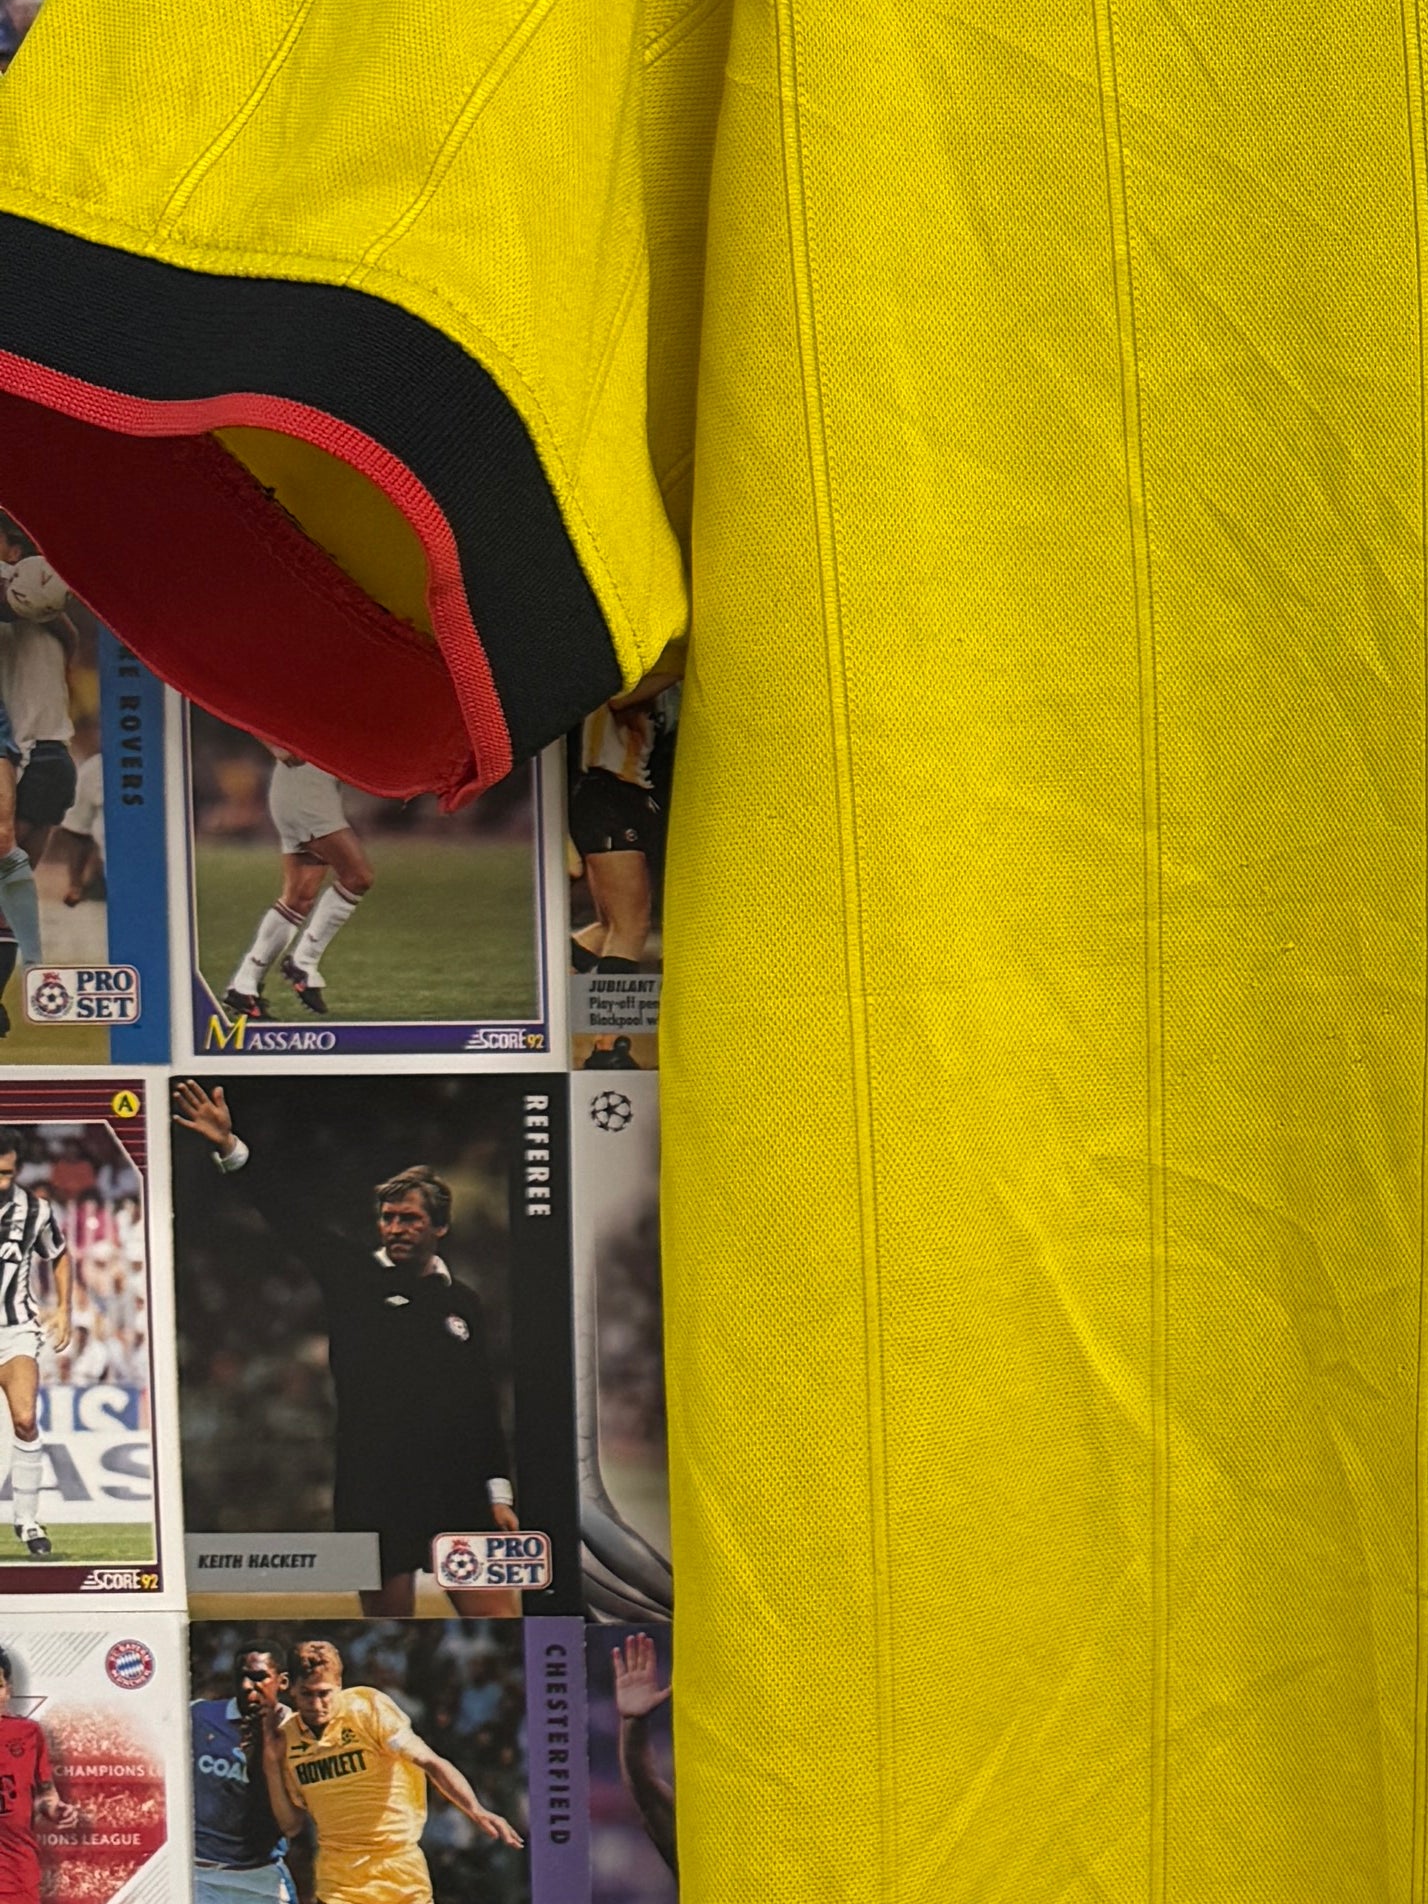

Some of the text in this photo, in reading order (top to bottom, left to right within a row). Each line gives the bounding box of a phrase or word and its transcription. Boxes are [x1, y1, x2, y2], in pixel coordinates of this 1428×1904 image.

[119, 696, 144, 807] ROVERS
[76, 970, 134, 992] PRO
[588, 979, 656, 994] JUBILANT
[76, 997, 134, 1019] SET
[204, 1015, 335, 1052] MASSARO
[524, 1095, 551, 1217] REFEREE
[486, 1537, 544, 1559] PRO
[197, 1553, 317, 1570] KEITH HACKETT
[485, 1563, 543, 1585] SET
[545, 1644, 570, 1845] CHESTERFIELD
